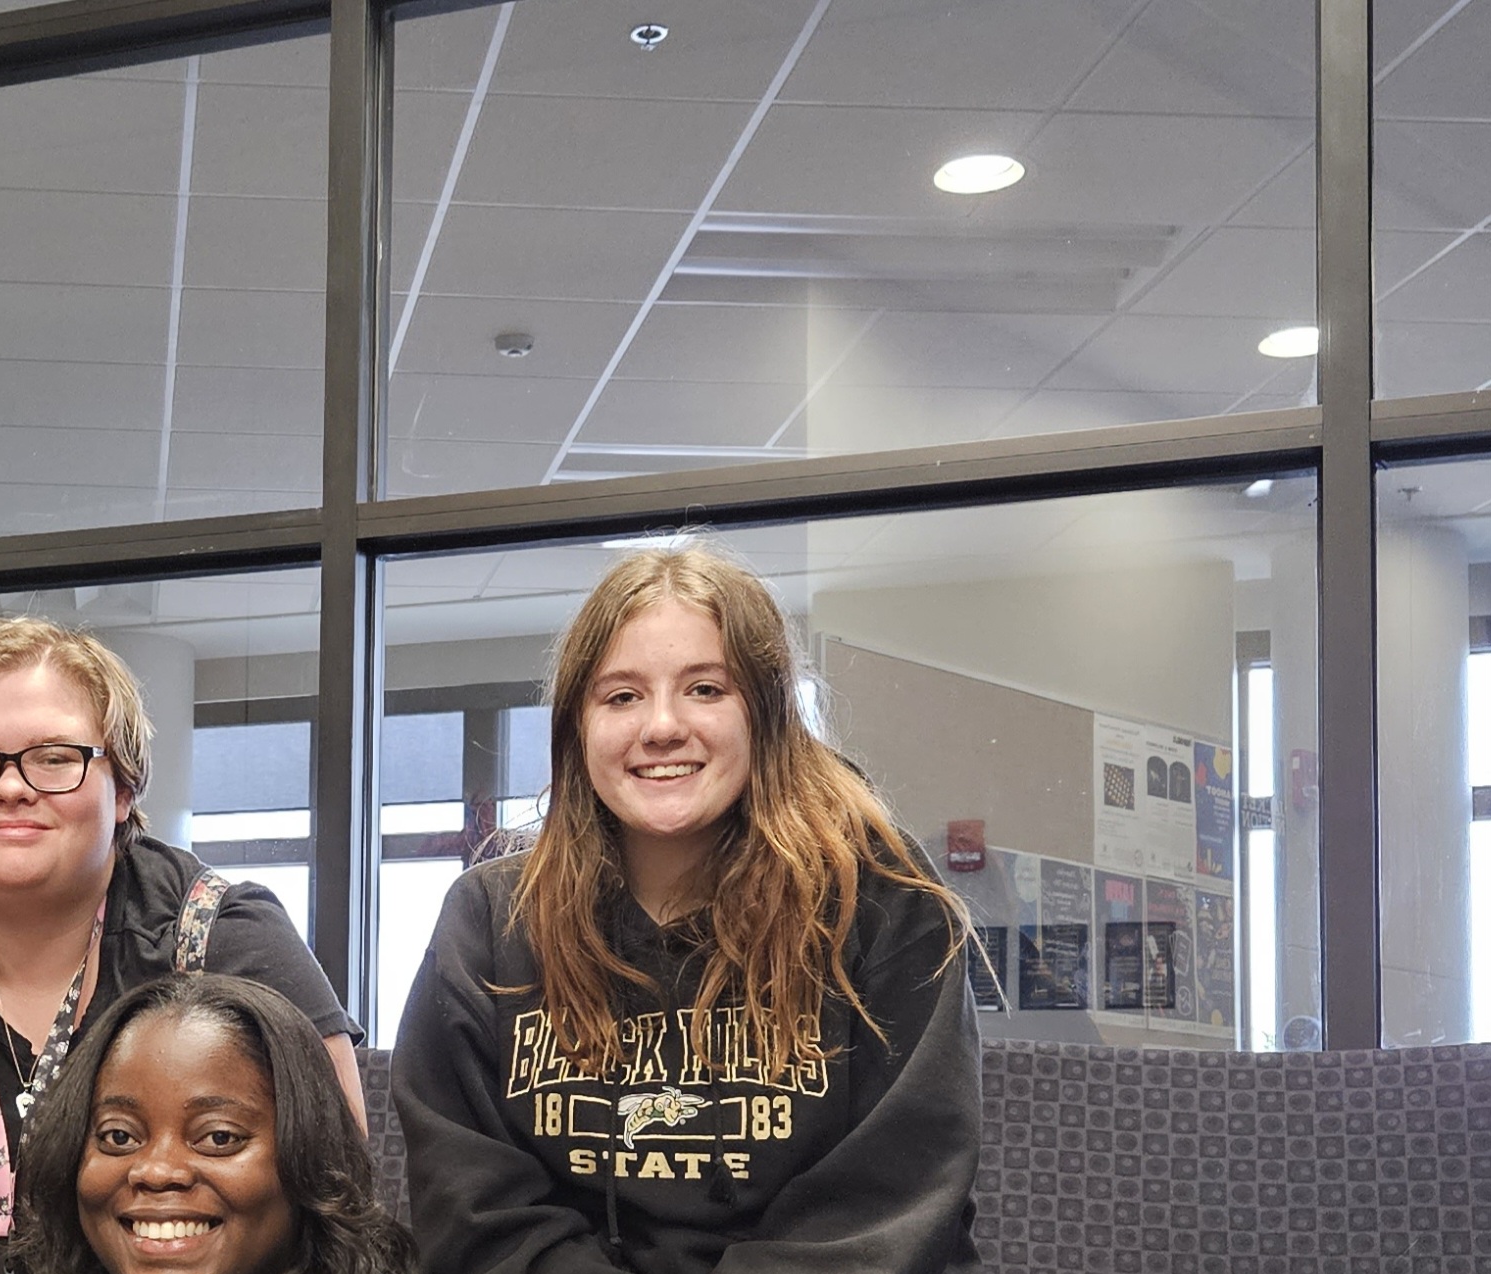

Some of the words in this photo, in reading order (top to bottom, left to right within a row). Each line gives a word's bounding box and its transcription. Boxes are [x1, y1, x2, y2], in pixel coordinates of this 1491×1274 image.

[534, 1093, 563, 1136] 18
[752, 1095, 792, 1140] 83
[569, 1149, 750, 1179] STATE
